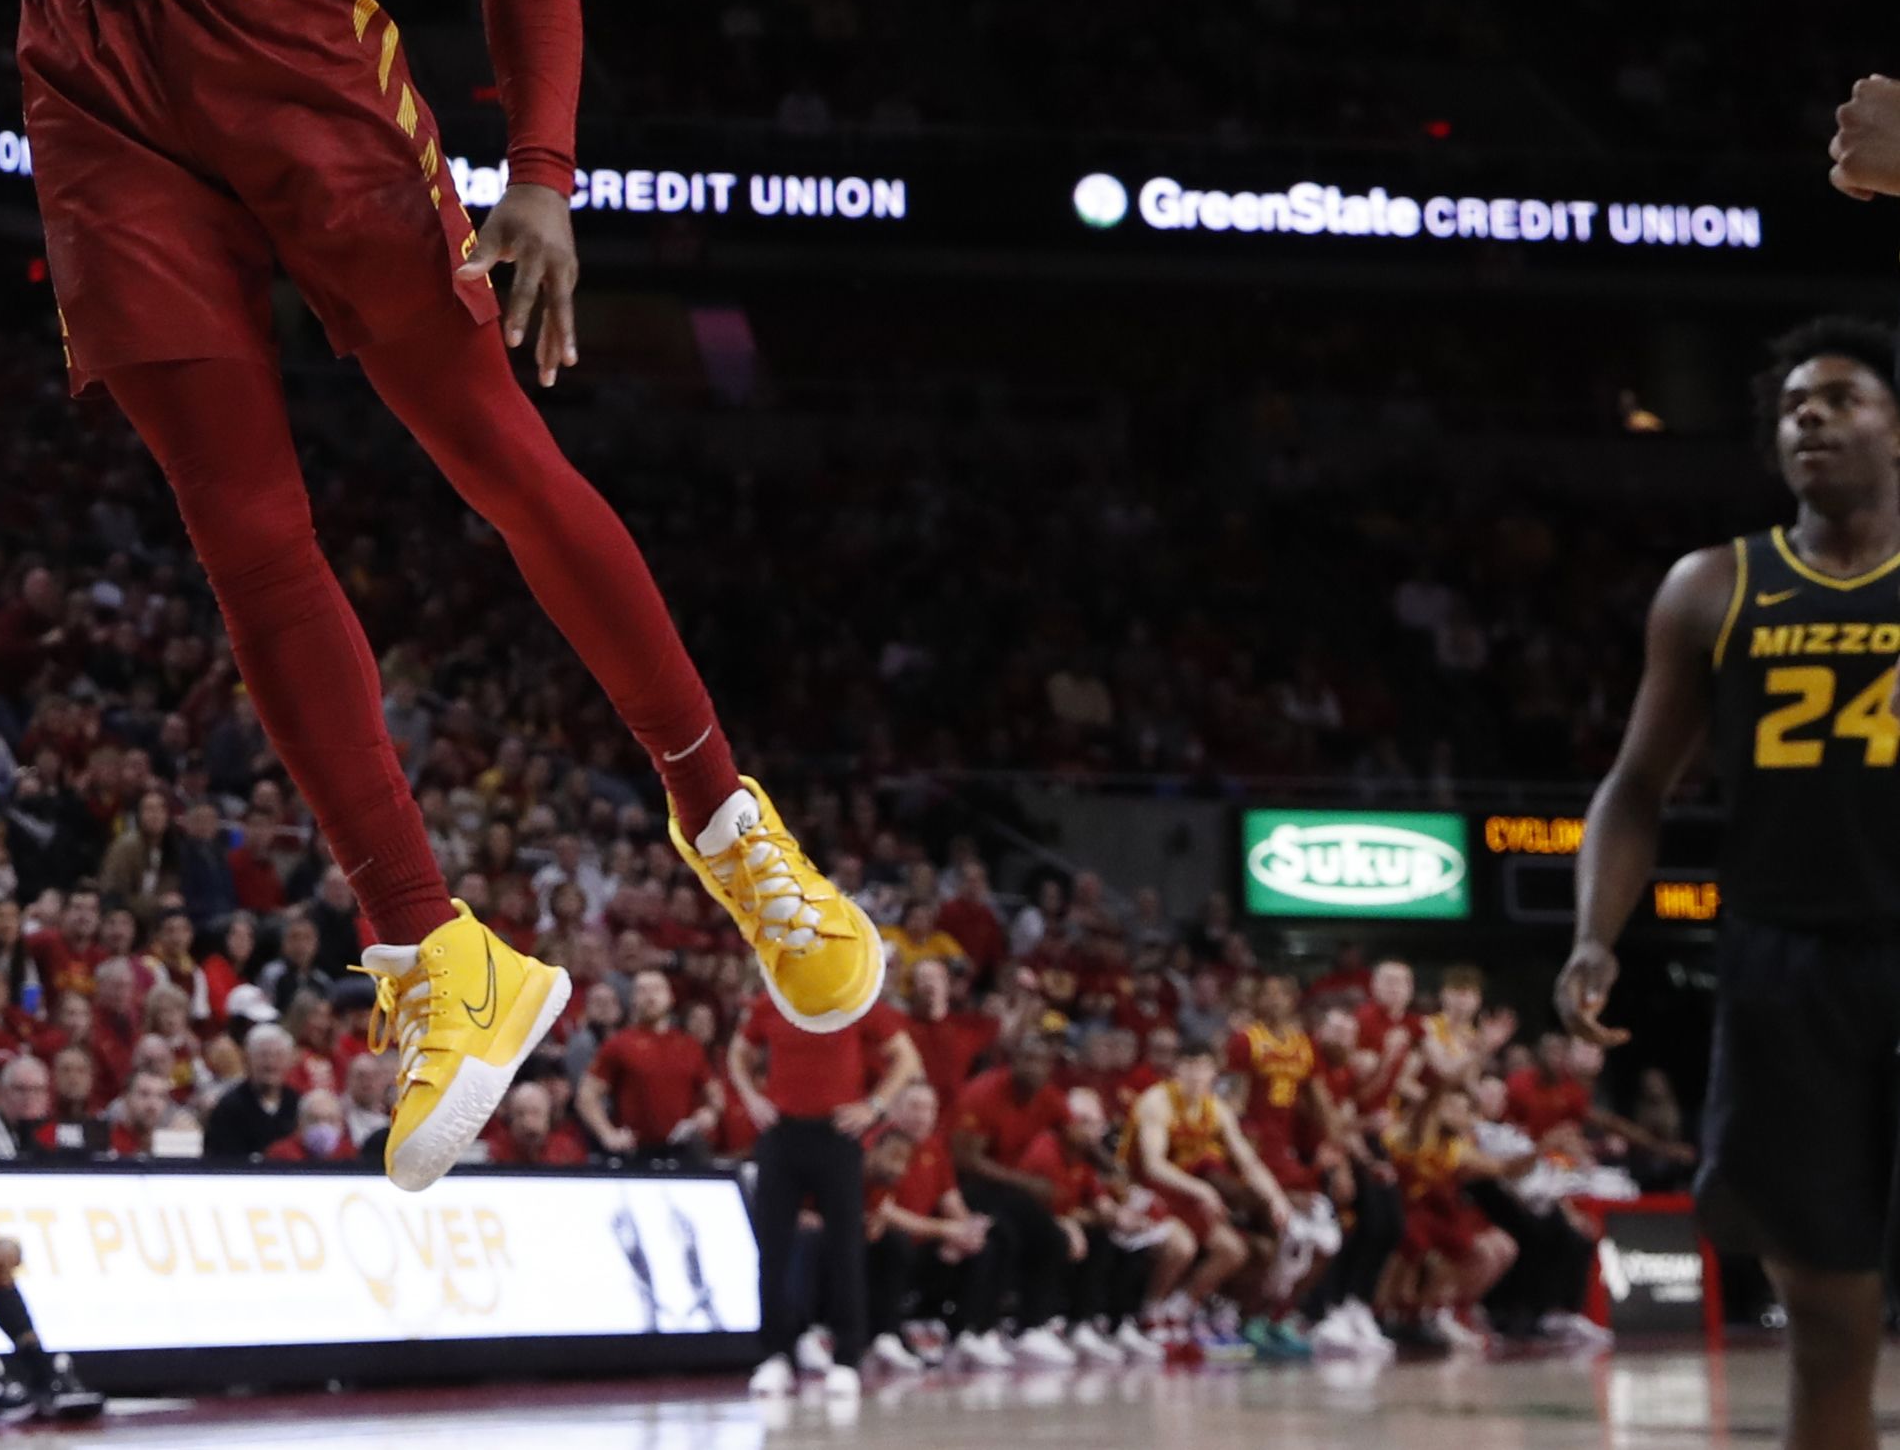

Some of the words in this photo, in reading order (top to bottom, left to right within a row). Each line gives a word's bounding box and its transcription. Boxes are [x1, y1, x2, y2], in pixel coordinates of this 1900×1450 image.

[749, 174, 906, 219] UNION
[1138, 177, 1421, 238] GreenState
[1423, 197, 1598, 242] CREDIT
[1608, 204, 1762, 248] UNION
[1754, 664, 1900, 768] 24
[83, 1207, 327, 1275] PULLED
